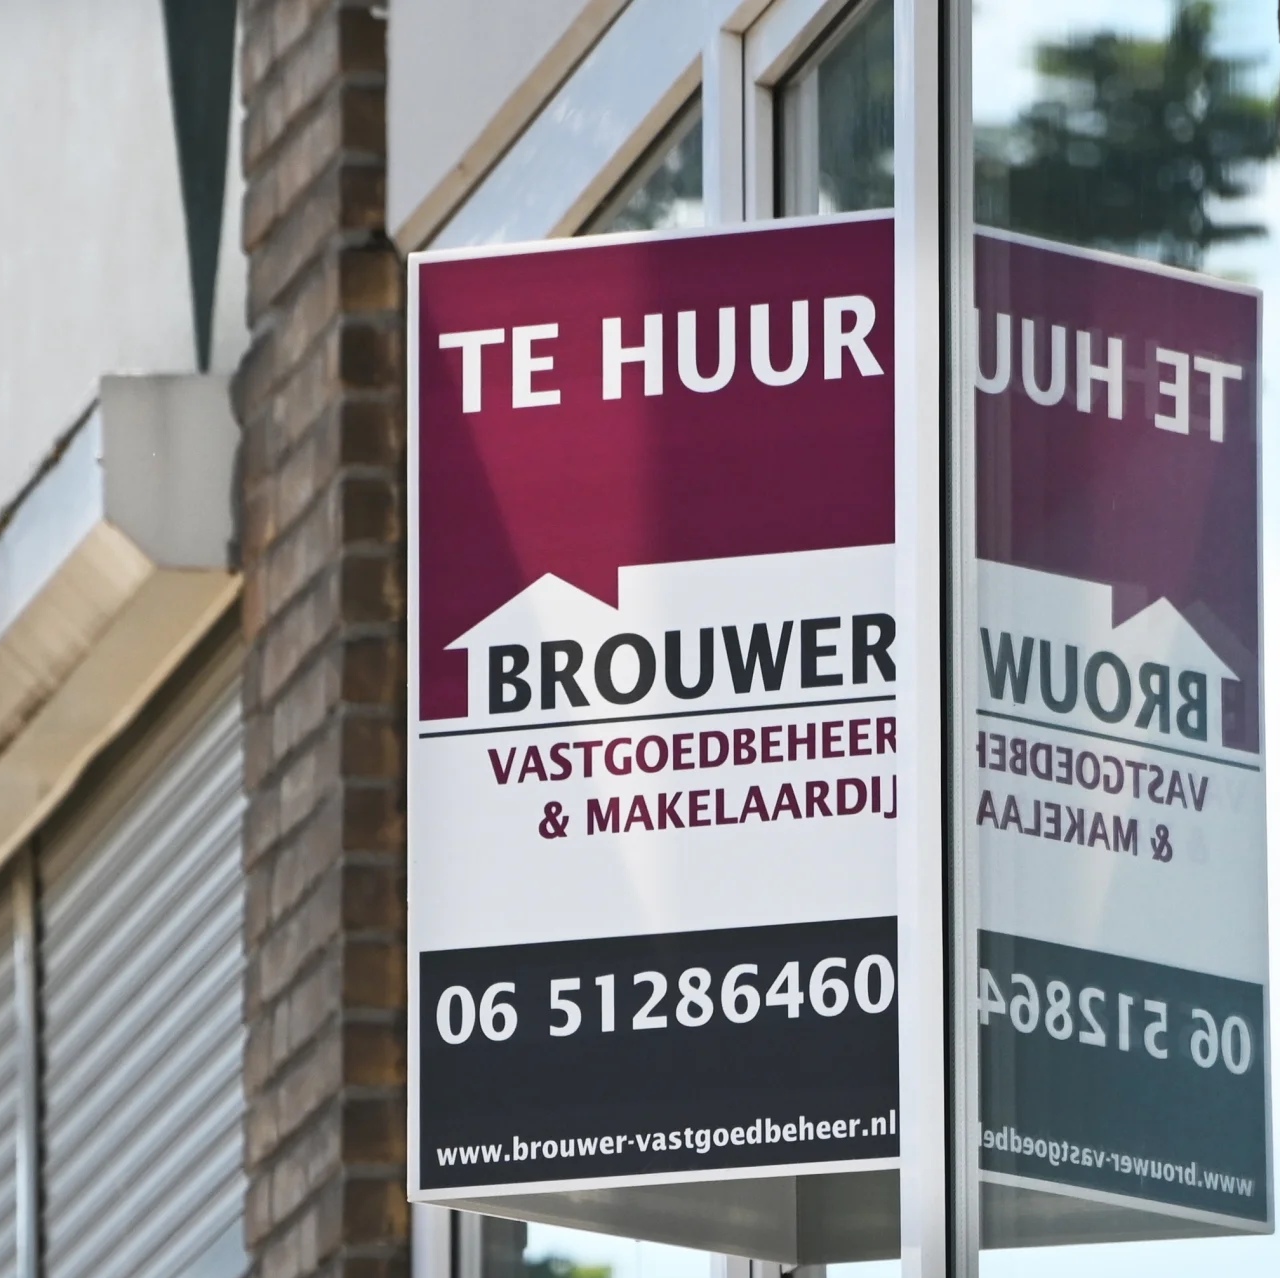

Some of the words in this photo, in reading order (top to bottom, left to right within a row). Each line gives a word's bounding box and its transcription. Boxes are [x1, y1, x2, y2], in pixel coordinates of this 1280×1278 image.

[438, 322, 561, 413] TE
[601, 294, 884, 401] HUUR
[488, 612, 896, 715] BROUWER
[488, 716, 896, 785] VASTGOEDBEHEER
[537, 802, 569, 840] &
[585, 774, 897, 836] MAKELAARDIJ
[435, 981, 519, 1046] 06
[548, 953, 897, 1038] 51286460
[436, 1109, 898, 1167] www.brouwer-vastgoedbeheer.nl
